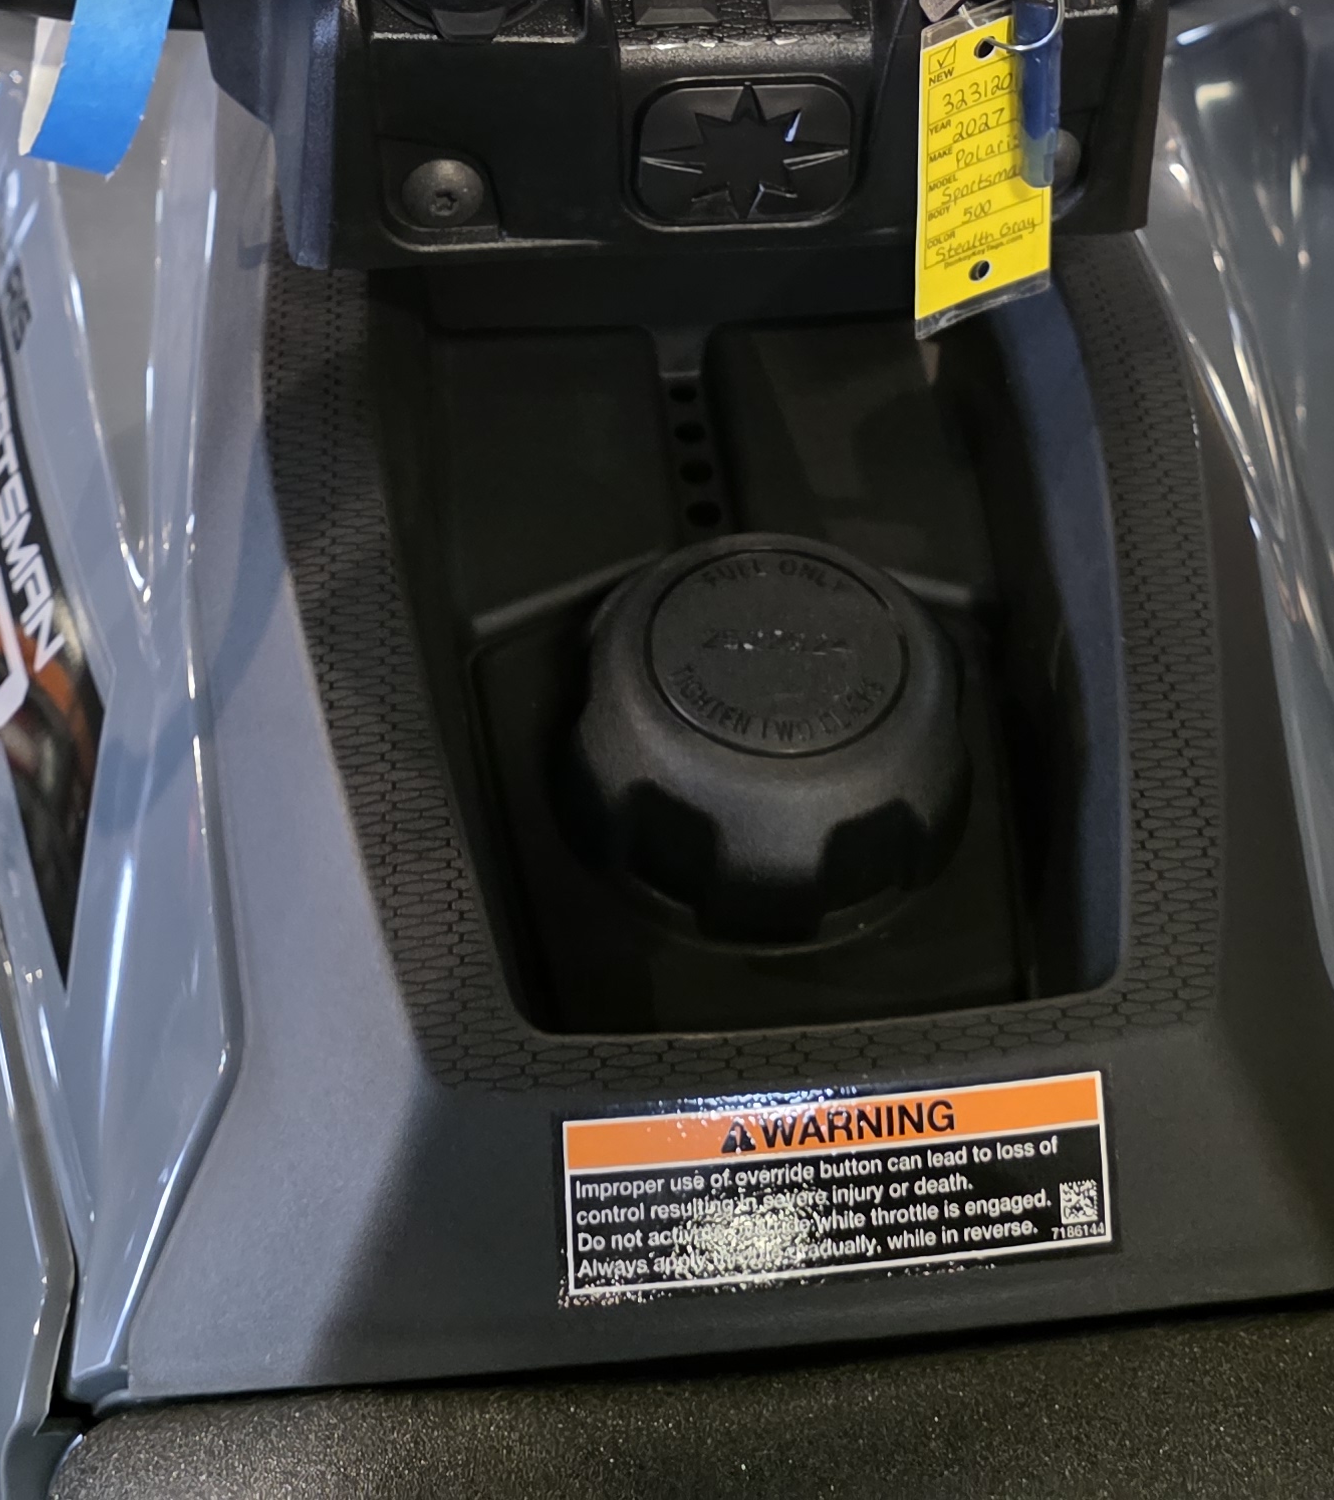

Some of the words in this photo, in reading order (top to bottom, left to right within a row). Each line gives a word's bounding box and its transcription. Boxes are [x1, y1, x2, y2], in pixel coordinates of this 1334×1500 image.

[928, 66, 955, 86] NEW
[942, 71, 1014, 115] 323120
[929, 119, 952, 136] YEAR
[952, 107, 1005, 144] 2027
[929, 146, 953, 164] MAKE
[928, 174, 959, 192] MODEL
[941, 164, 1022, 206] Sportsma
[928, 206, 951, 222] BODY
[962, 199, 992, 225] 500
[927, 231, 956, 249] COLOR
[935, 231, 995, 263] Stealth
[999, 217, 1037, 237] Gray
[761, 1100, 954, 1149] WARNING
[576, 1178, 664, 1201] Improper
[671, 1173, 704, 1191] use
[711, 1169, 731, 1188] of
[735, 1163, 814, 1186] override
[820, 1157, 882, 1180] button
[887, 1154, 922, 1172] can
[927, 1146, 967, 1167] lead
[972, 1146, 991, 1163] to
[997, 1141, 1034, 1160] loss
[1039, 1135, 1058, 1155] of
[576, 1203, 644, 1225] control
[650, 1197, 733, 1220] resulting
[832, 1184, 884, 1204] injury
[889, 1182, 909, 1198] or
[914, 1173, 973, 1194] death.
[577, 1232, 605, 1252] Do
[611, 1230, 643, 1250] not
[817, 1206, 865, 1235] while
[871, 1203, 938, 1225] throttle
[944, 1200, 959, 1218] is
[965, 1189, 1051, 1216] engaged.
[1051, 1222, 1104, 1239] 7186144
[578, 1258, 647, 1280] Always
[654, 1253, 706, 1280] apply
[888, 1229, 936, 1250] while
[942, 1226, 958, 1243] in
[964, 1219, 1037, 1241] reverse.
